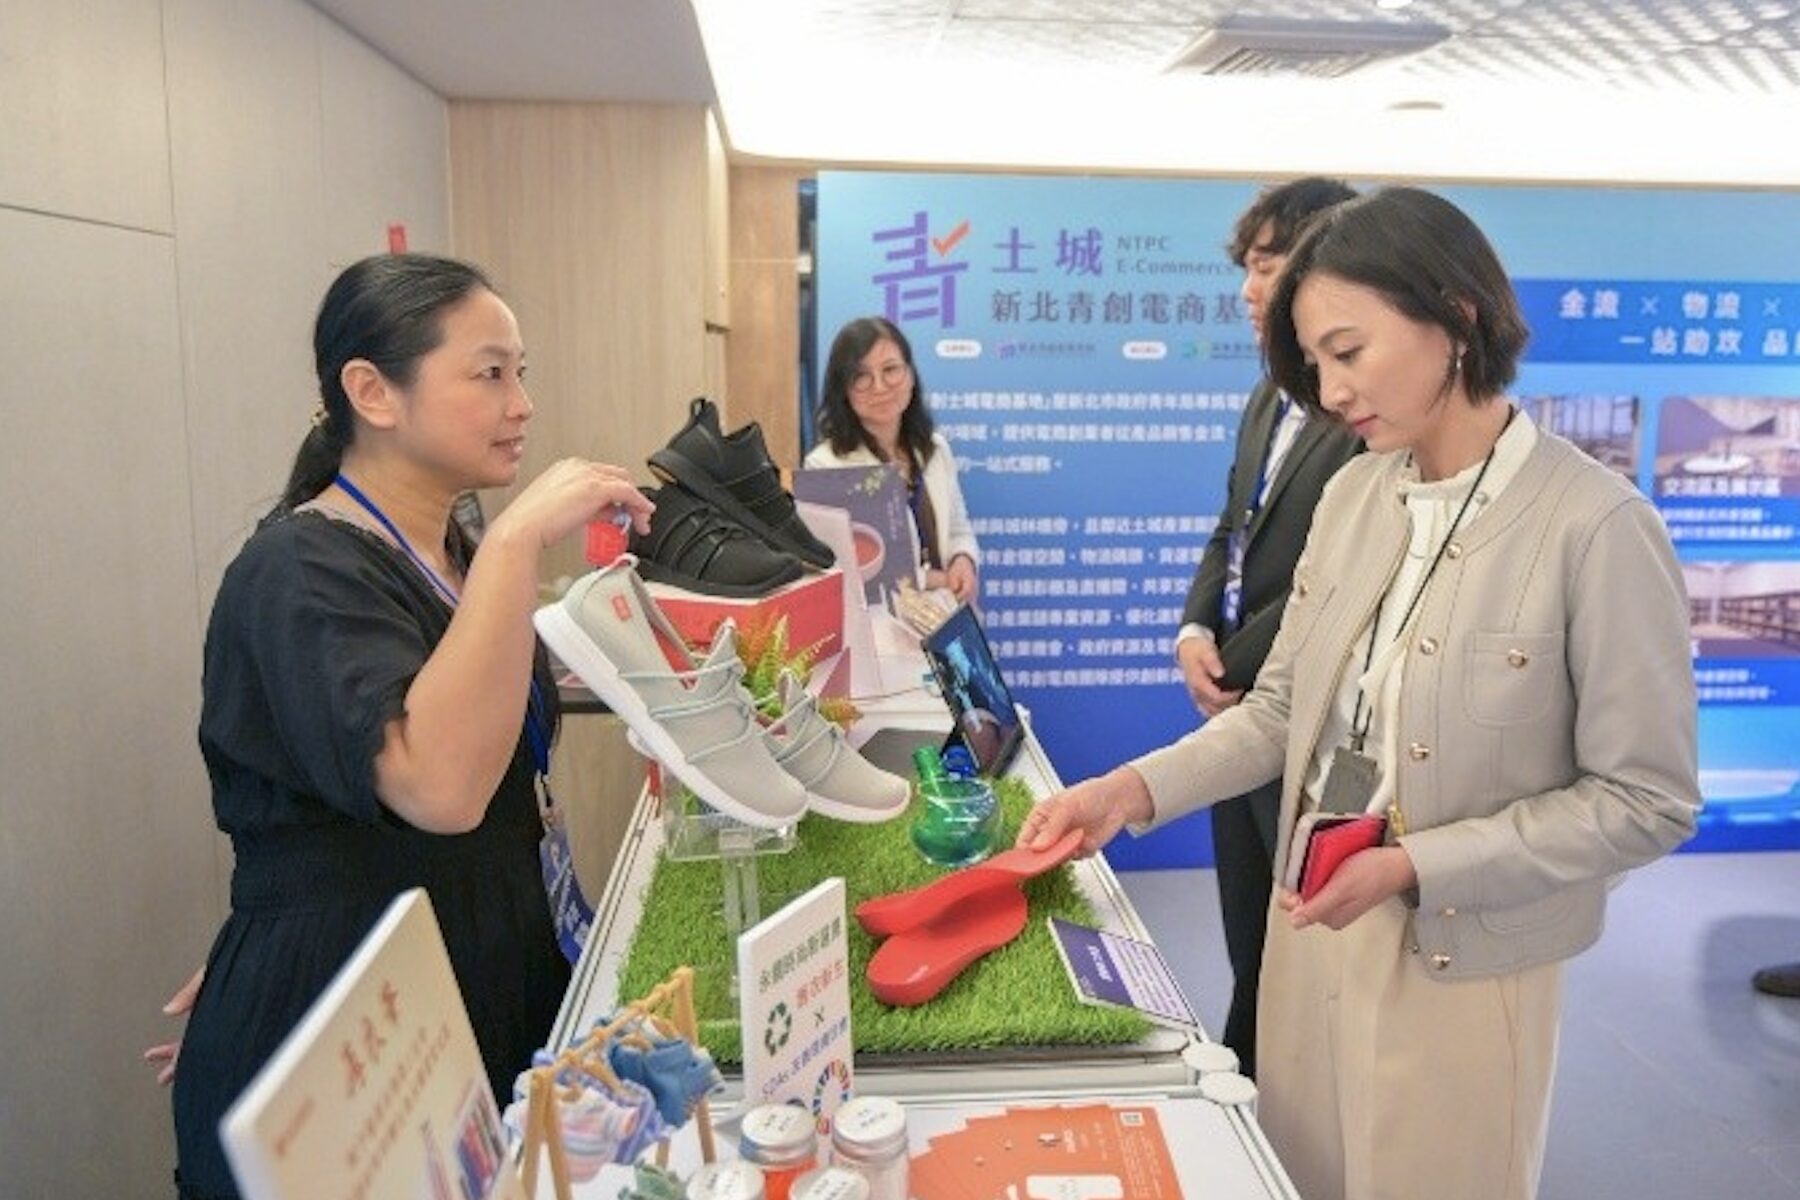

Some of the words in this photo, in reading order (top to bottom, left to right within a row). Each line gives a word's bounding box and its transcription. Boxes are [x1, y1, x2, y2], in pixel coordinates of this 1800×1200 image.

[991, 227, 1103, 276] 土城
[1117, 235, 1170, 251] NTPC
[991, 290, 1243, 325] 新北青創電商基
[1559, 288, 1620, 319] 金流
[1682, 290, 1741, 319] 物流
[1762, 328, 1800, 356] 品
